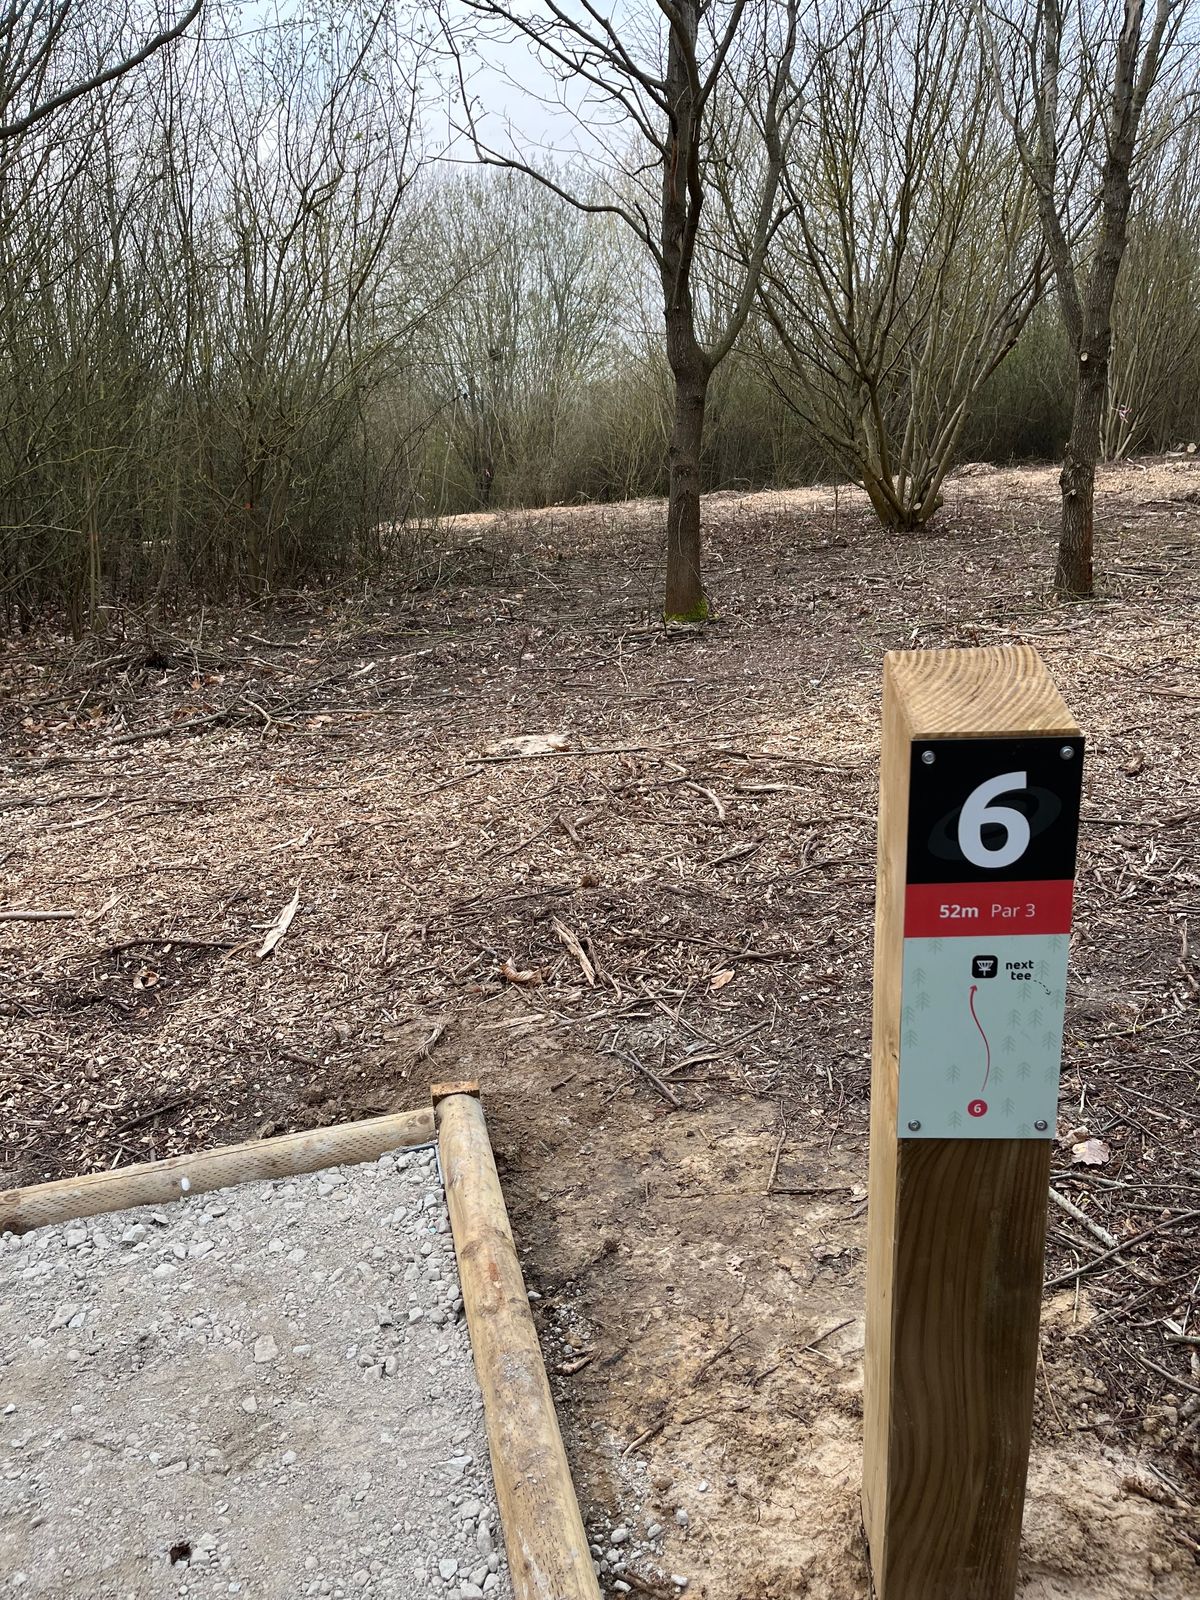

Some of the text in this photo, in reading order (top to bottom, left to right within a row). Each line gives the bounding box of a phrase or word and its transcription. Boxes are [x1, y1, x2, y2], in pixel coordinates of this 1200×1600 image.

[958, 771, 1030, 868] 6
[939, 903, 1036, 918] 52m Par 3
[1006, 960, 1034, 970] next
[1010, 971, 1032, 981] tee
[973, 1103, 982, 1113] 6
